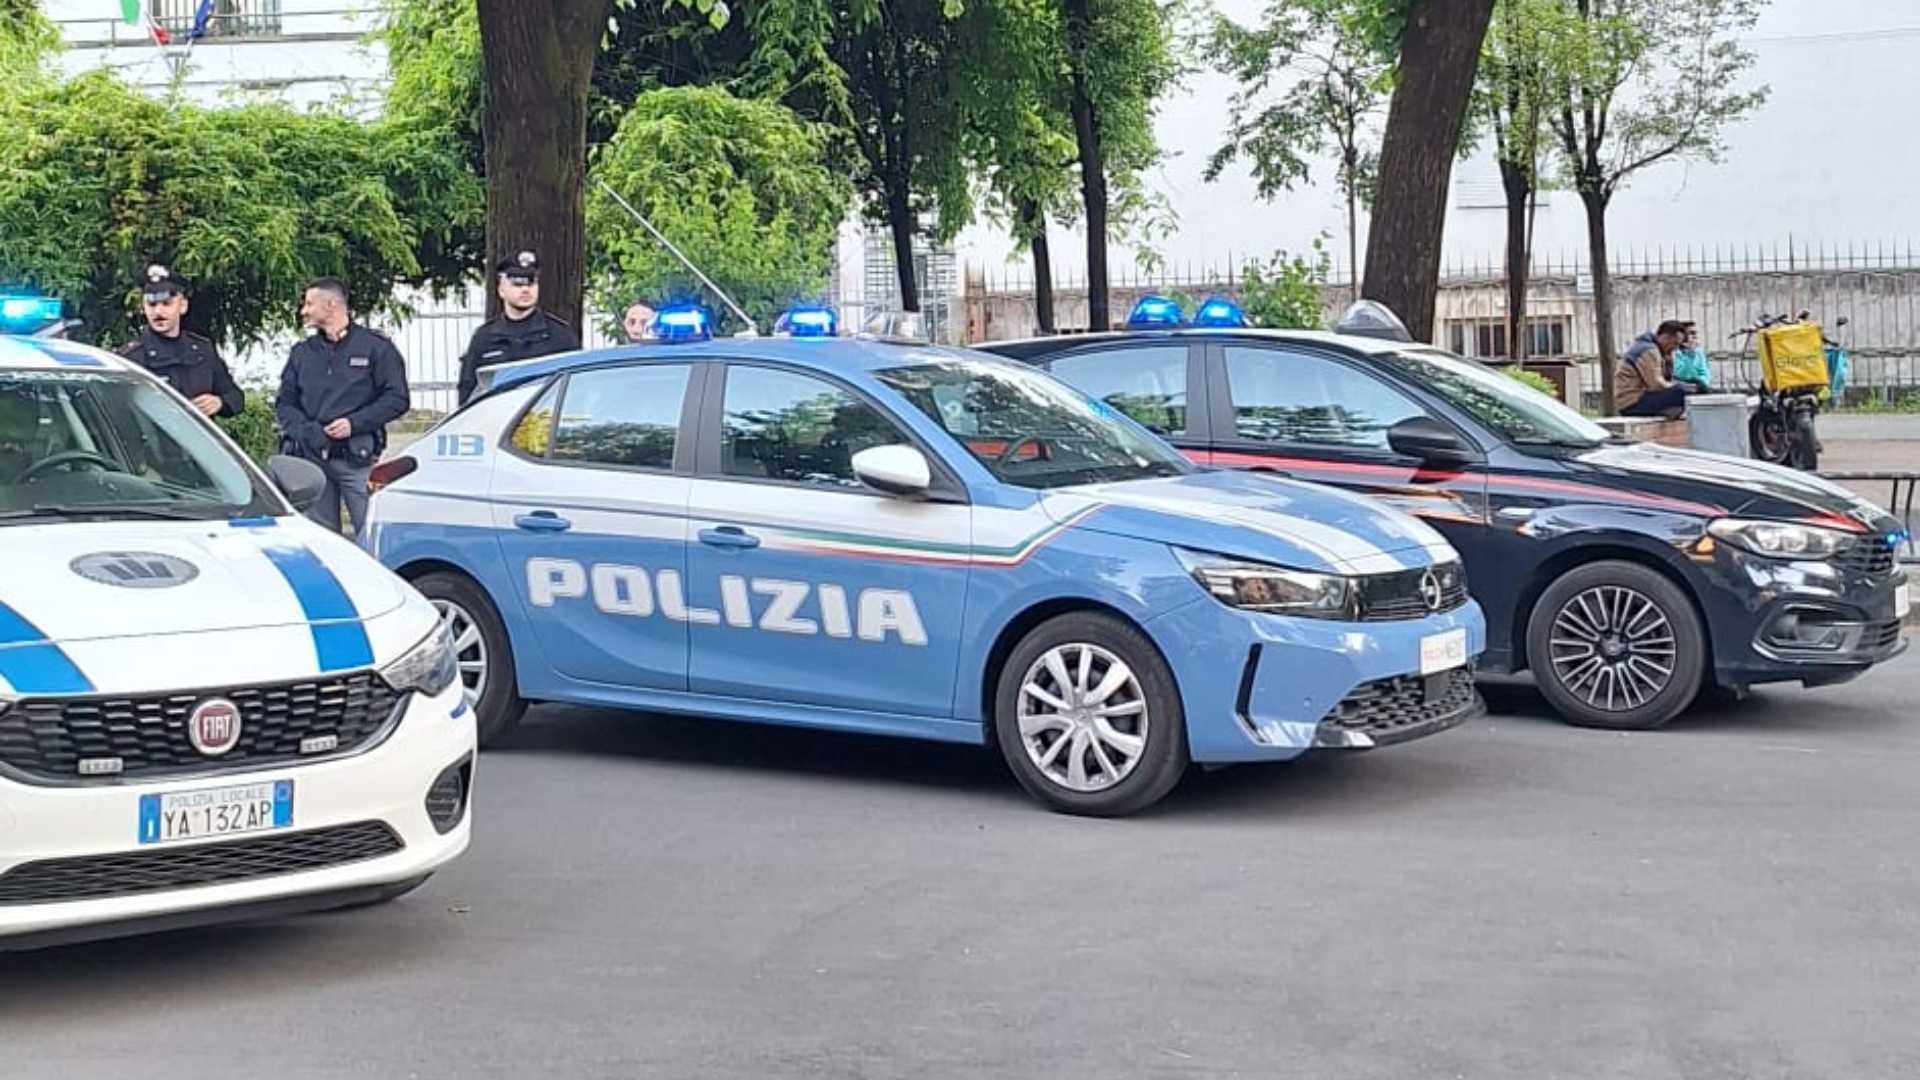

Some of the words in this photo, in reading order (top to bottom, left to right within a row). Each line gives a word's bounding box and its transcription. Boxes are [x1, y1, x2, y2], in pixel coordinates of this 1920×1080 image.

[437, 433, 485, 457] 113
[526, 556, 929, 646] POLIZIA
[203, 714, 232, 740] FIAT
[169, 794, 215, 808] POLIZIA
[164, 809, 191, 837] YA
